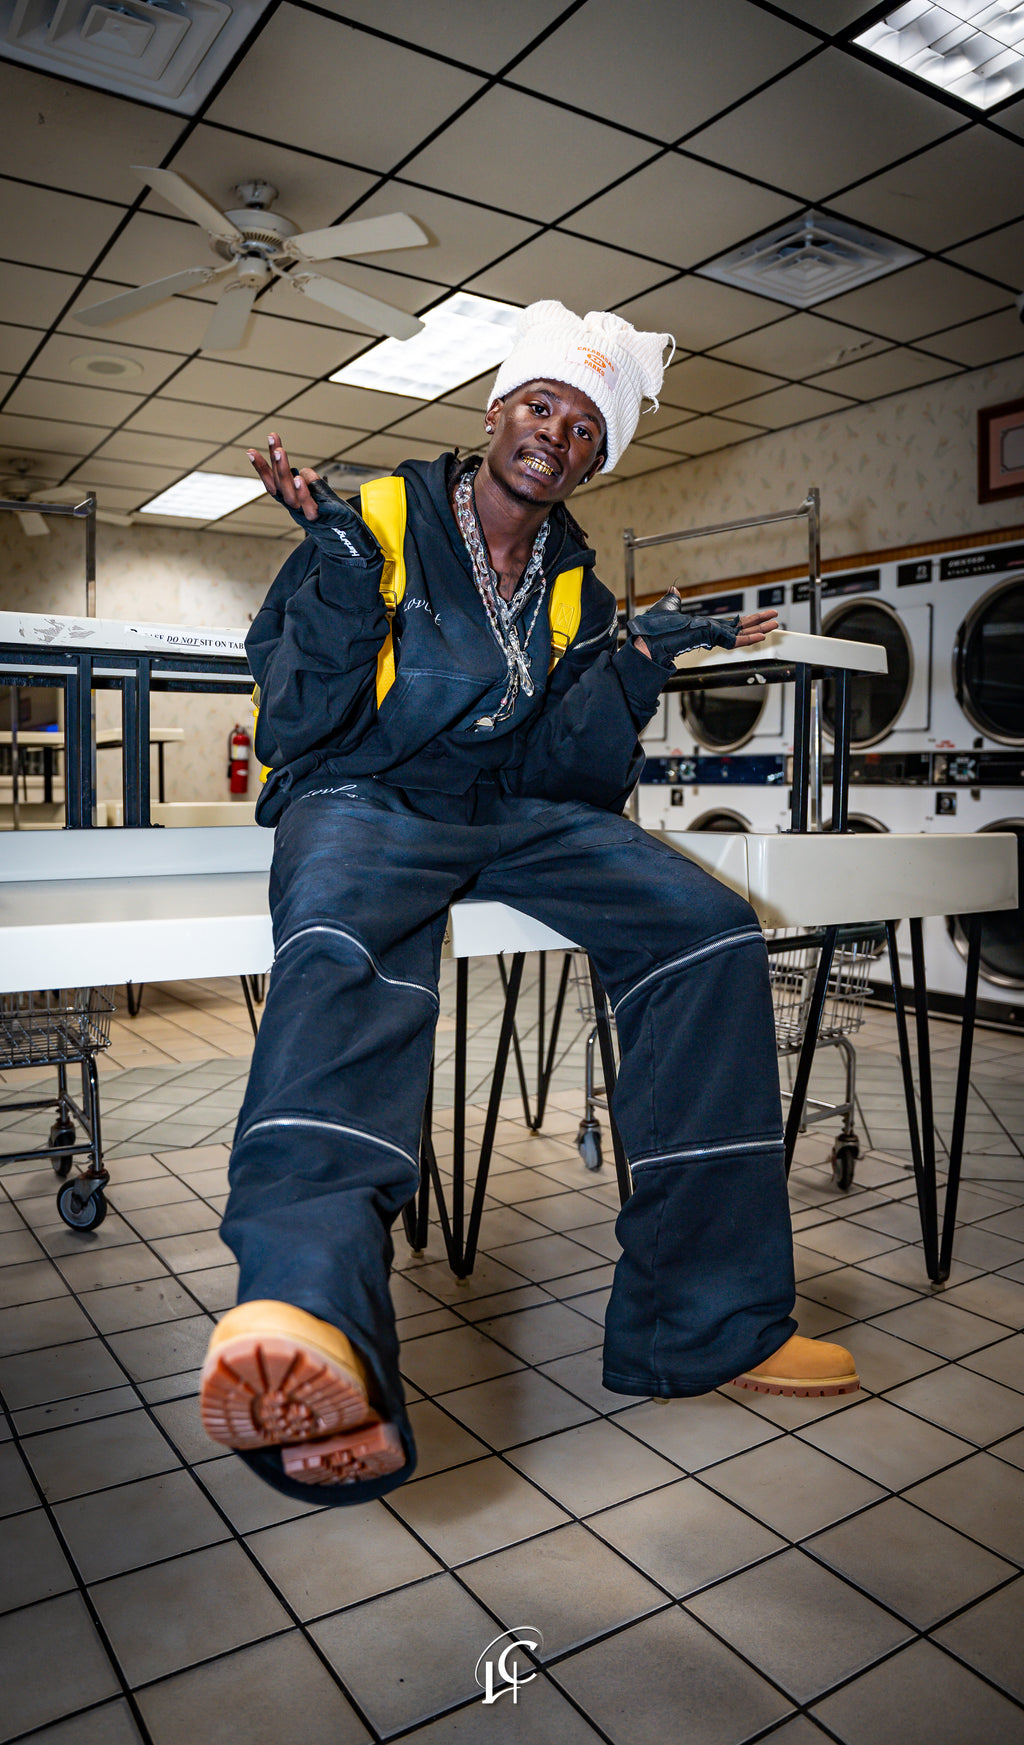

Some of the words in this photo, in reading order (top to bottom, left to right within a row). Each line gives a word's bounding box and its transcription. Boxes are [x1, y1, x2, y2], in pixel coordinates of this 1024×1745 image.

[577, 346, 615, 372] CALABASAS
[584, 359, 605, 377] PARKS
[166, 635, 179, 644] DO
[180, 636, 200, 646] NOT
[200, 638, 213, 647] SIT
[214, 639, 227, 648] ON
[228, 641, 245, 649] TAB
